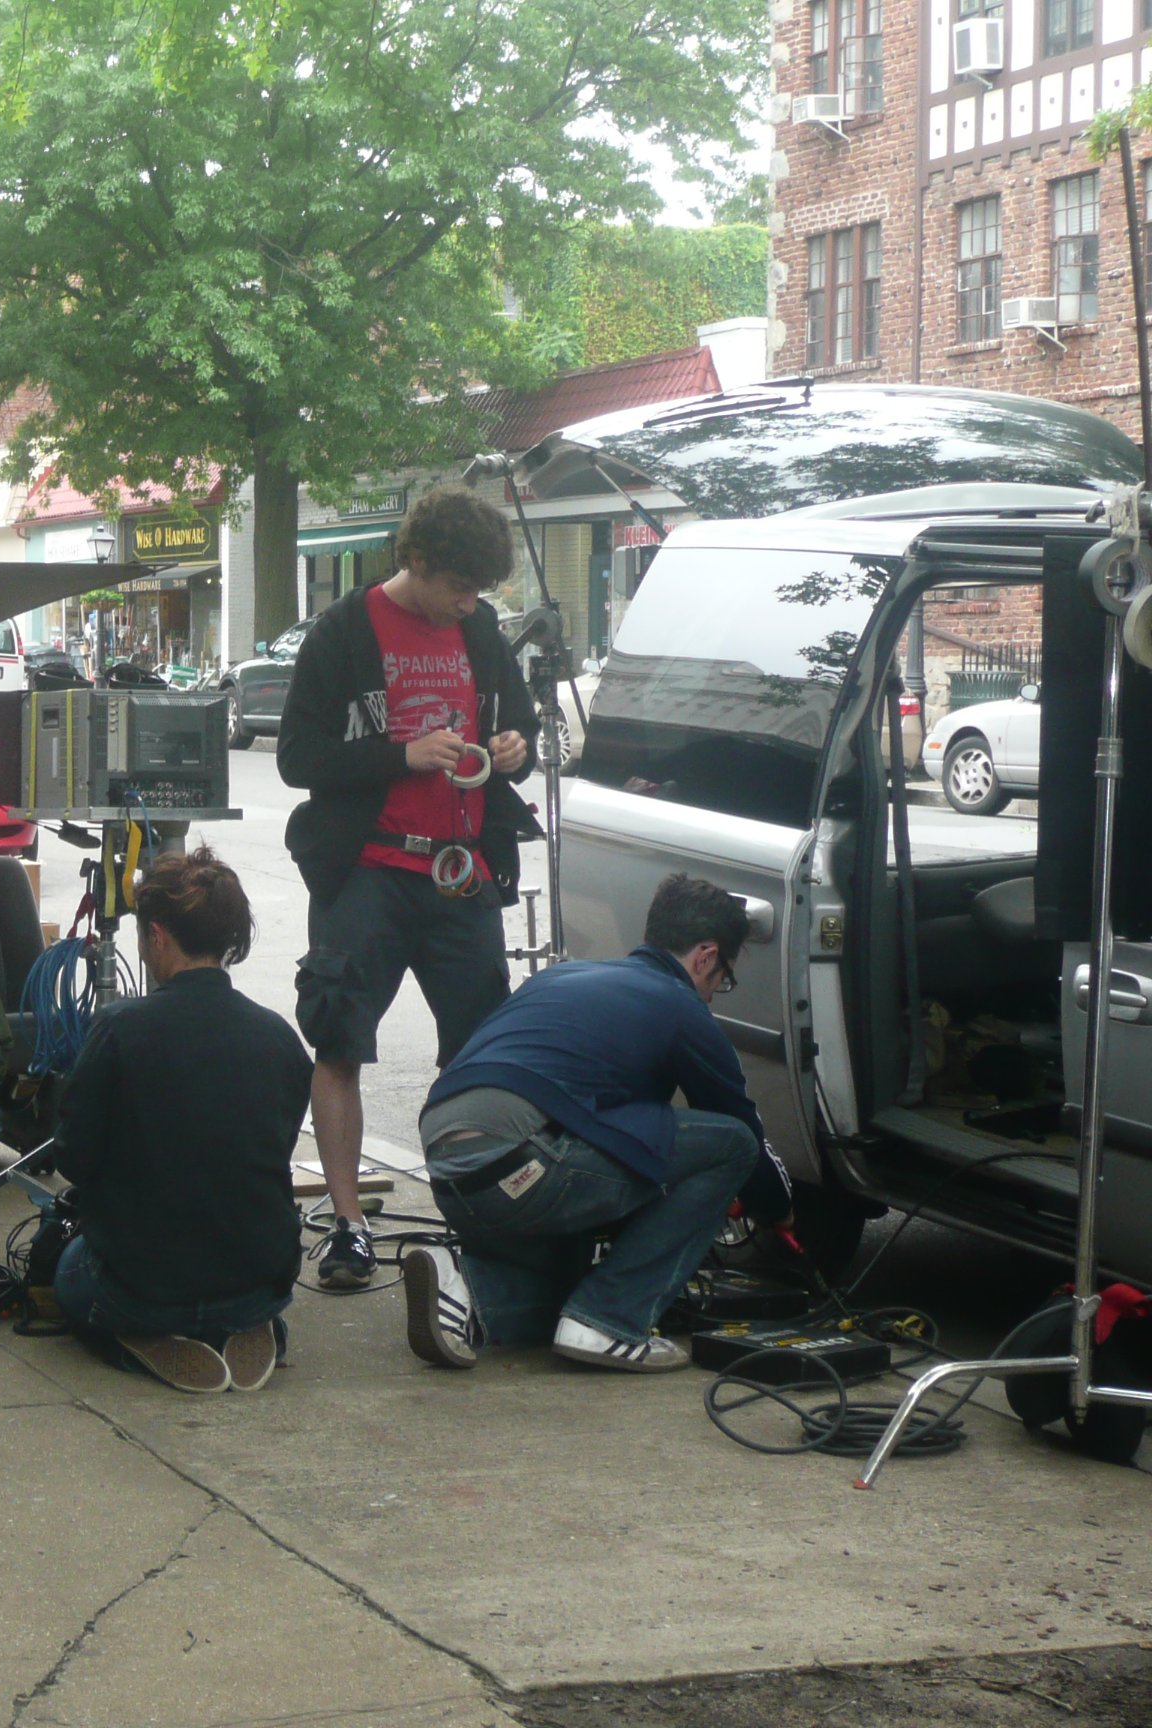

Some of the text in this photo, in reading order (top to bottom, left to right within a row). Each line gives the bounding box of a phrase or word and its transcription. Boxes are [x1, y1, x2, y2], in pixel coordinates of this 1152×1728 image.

[165, 527, 205, 547] HARDWARE
[132, 579, 161, 591] HARDWARE
[402, 679, 459, 688] AFFORDABLE
